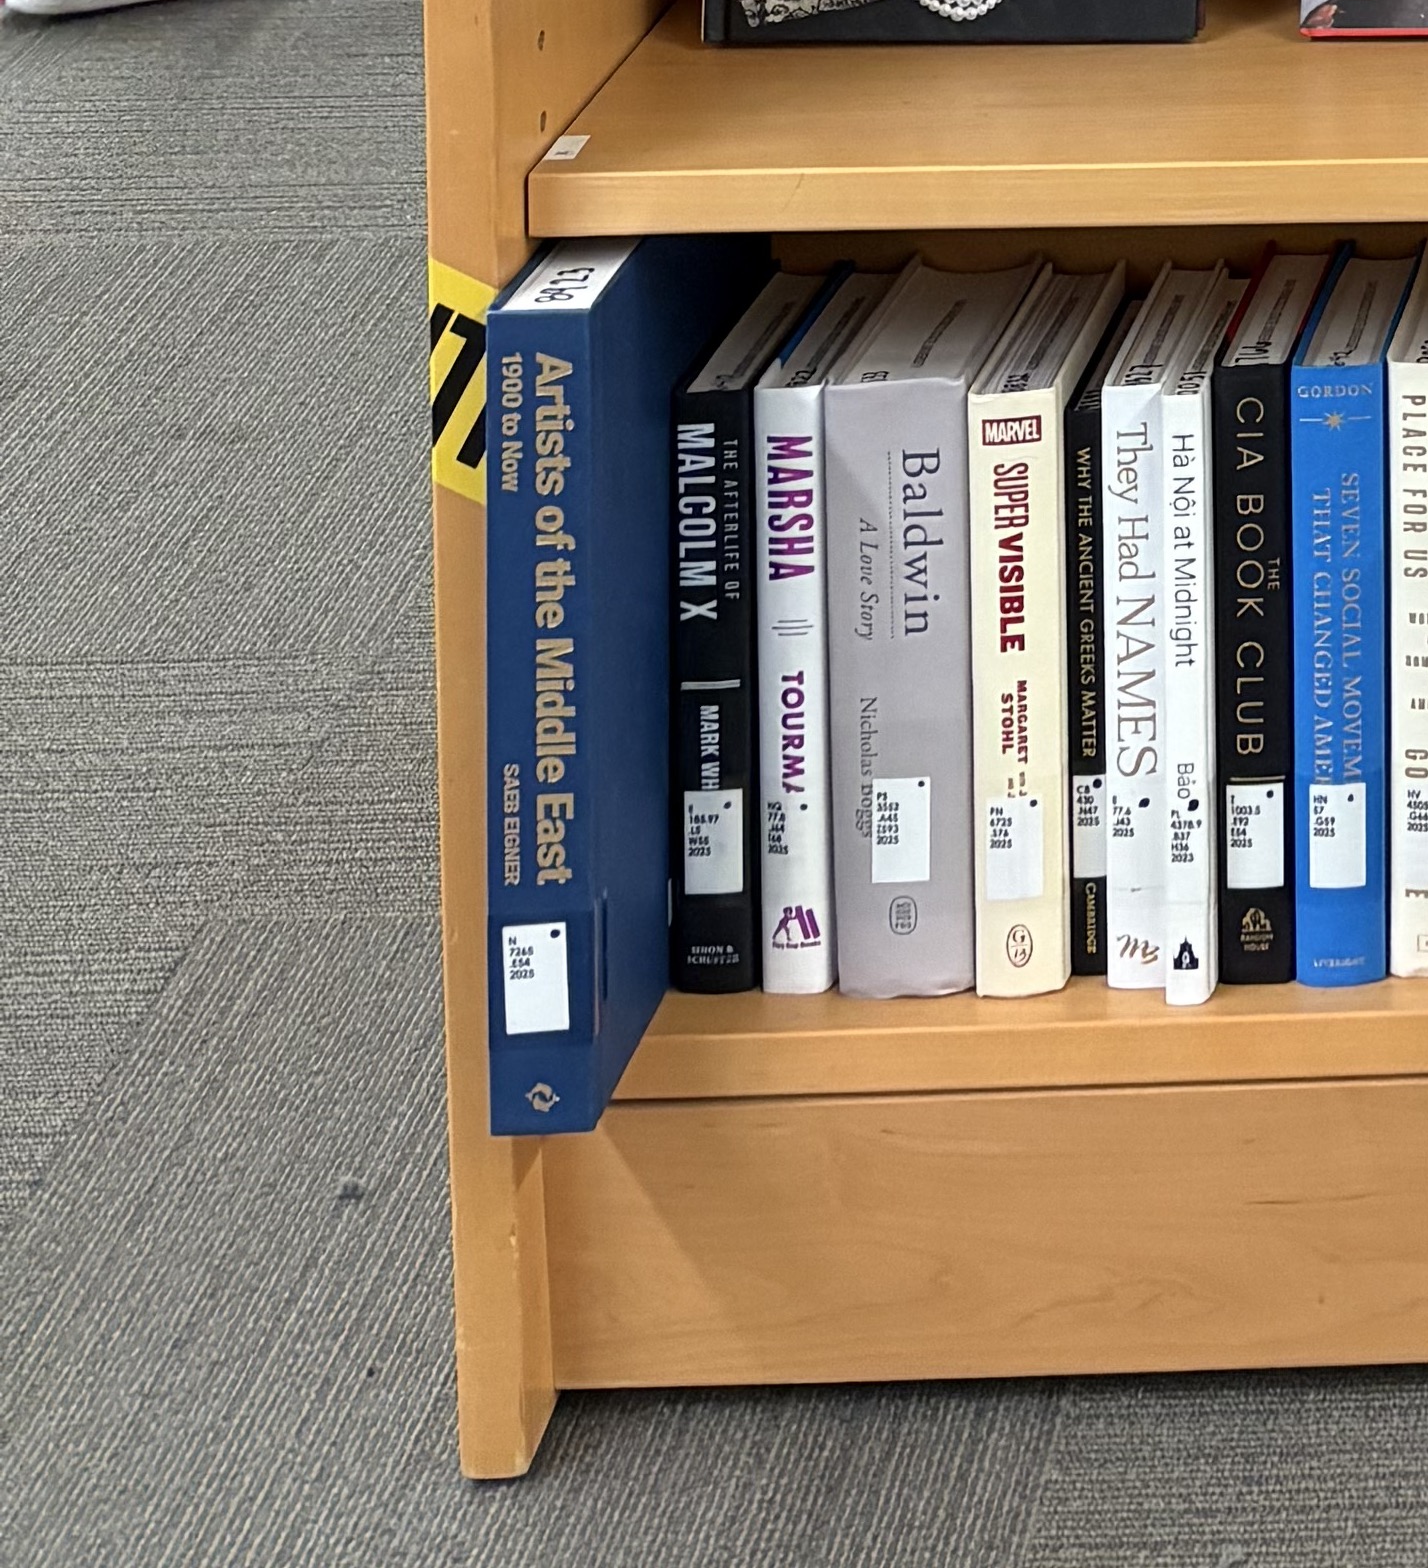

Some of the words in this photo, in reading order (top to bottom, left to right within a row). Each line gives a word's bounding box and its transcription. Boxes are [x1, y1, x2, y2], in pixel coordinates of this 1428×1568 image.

[535, 352, 574, 496] Artists
[984, 419, 1039, 442] MARVEL
[1108, 422, 1153, 504] They
[1236, 397, 1264, 470] CIA
[535, 506, 575, 551] of
[677, 423, 717, 587] MALCOLM
[767, 436, 814, 581] MARSHA
[860, 517, 878, 533] A
[993, 463, 1029, 530] SUPER
[860, 541, 878, 585] Love
[902, 448, 944, 636] Baldwin
[1118, 515, 1156, 582] Had
[1236, 494, 1264, 617] BOOK
[535, 558, 575, 629] the
[679, 601, 717, 621] X
[855, 591, 879, 640] Story
[998, 532, 1025, 653] VISIBLE
[536, 637, 576, 783] Middle
[1117, 594, 1158, 777] NAMES
[1236, 641, 1264, 754] CLUB
[536, 793, 574, 885] East
